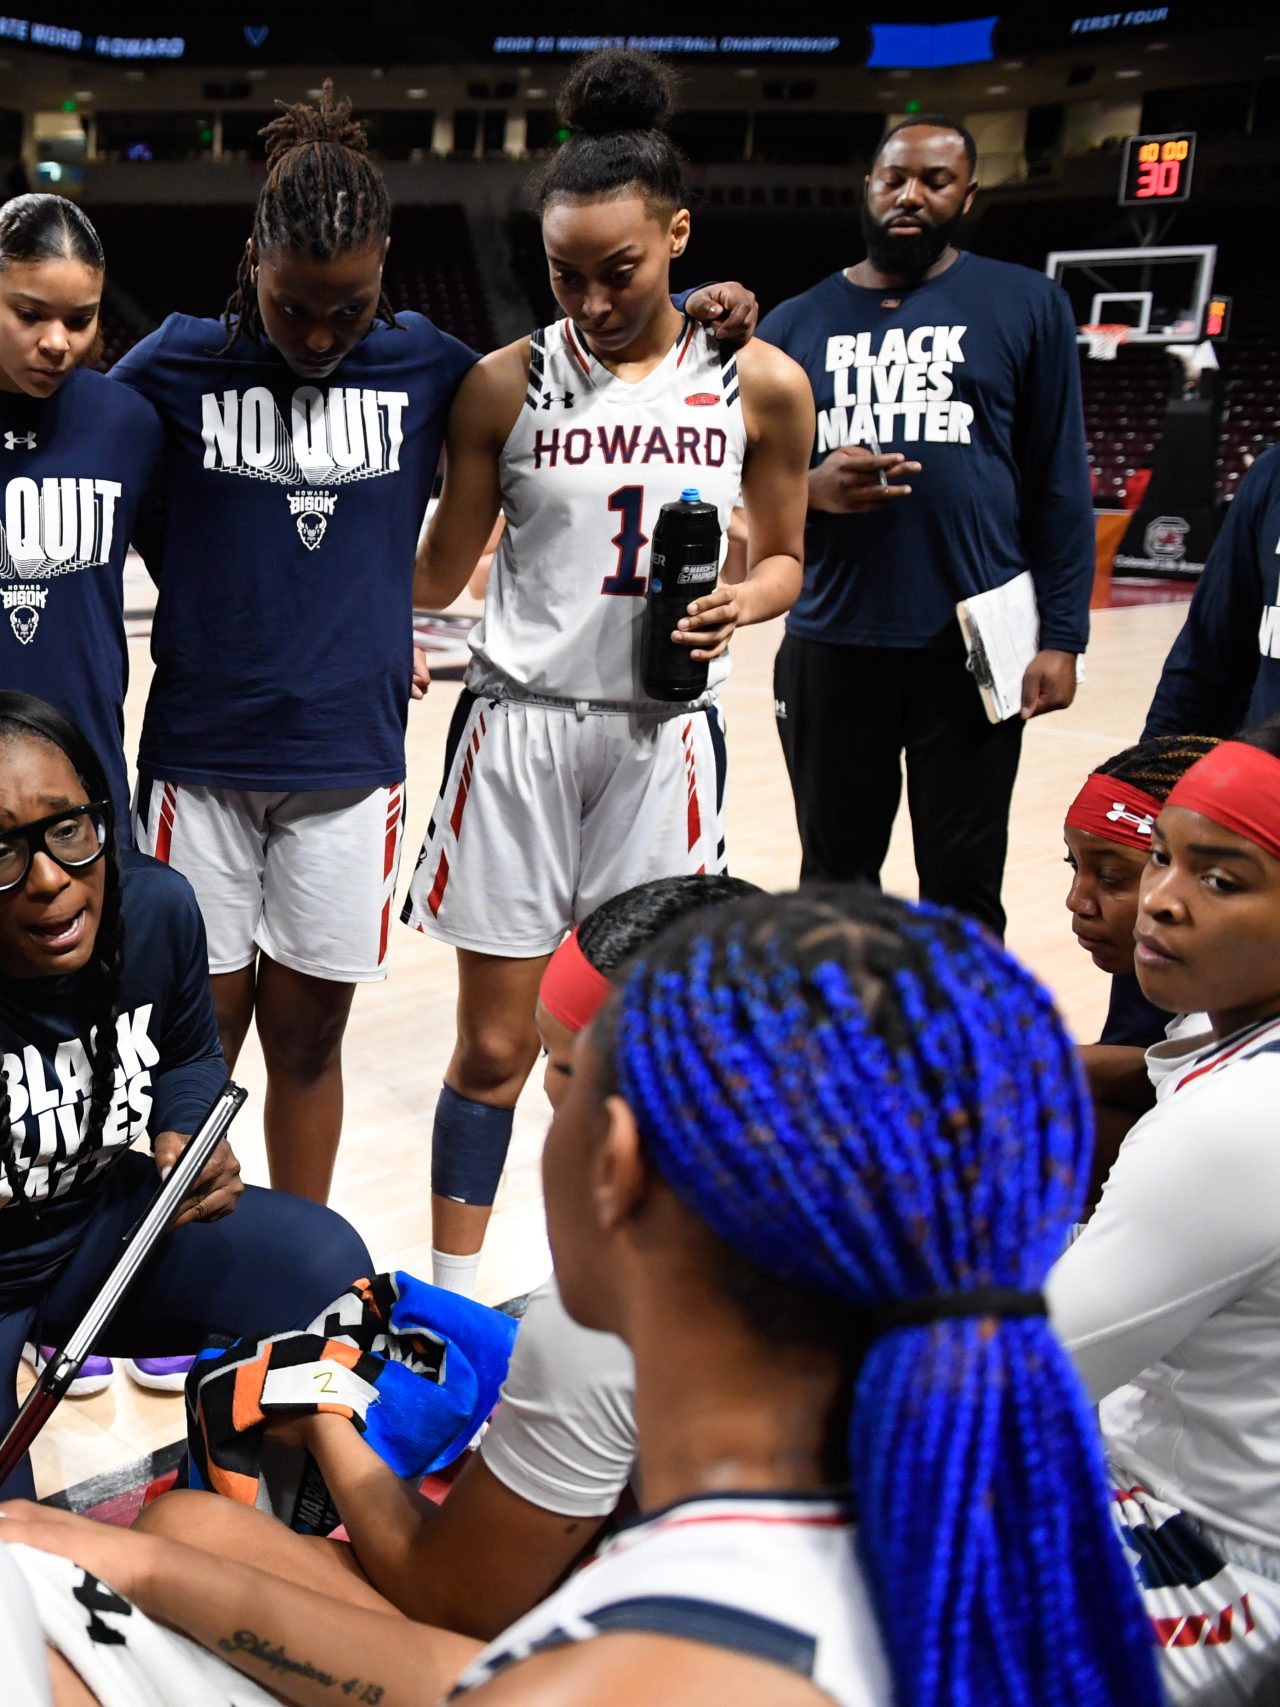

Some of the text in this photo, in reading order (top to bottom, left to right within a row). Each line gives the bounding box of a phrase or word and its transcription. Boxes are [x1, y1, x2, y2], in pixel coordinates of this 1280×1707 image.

[1136, 161, 1180, 198] 30
[825, 325, 967, 372] BLACK
[834, 360, 953, 407] LIVES
[201, 387, 409, 470] NO QUIT
[533, 424, 727, 469] HOWARD
[818, 401, 974, 453] MATTER
[5, 477, 122, 564] QUIT
[286, 493, 338, 515] BISON
[600, 484, 650, 597] 1
[0, 587, 49, 609] BISON
[313, 1371, 339, 1394] 2
